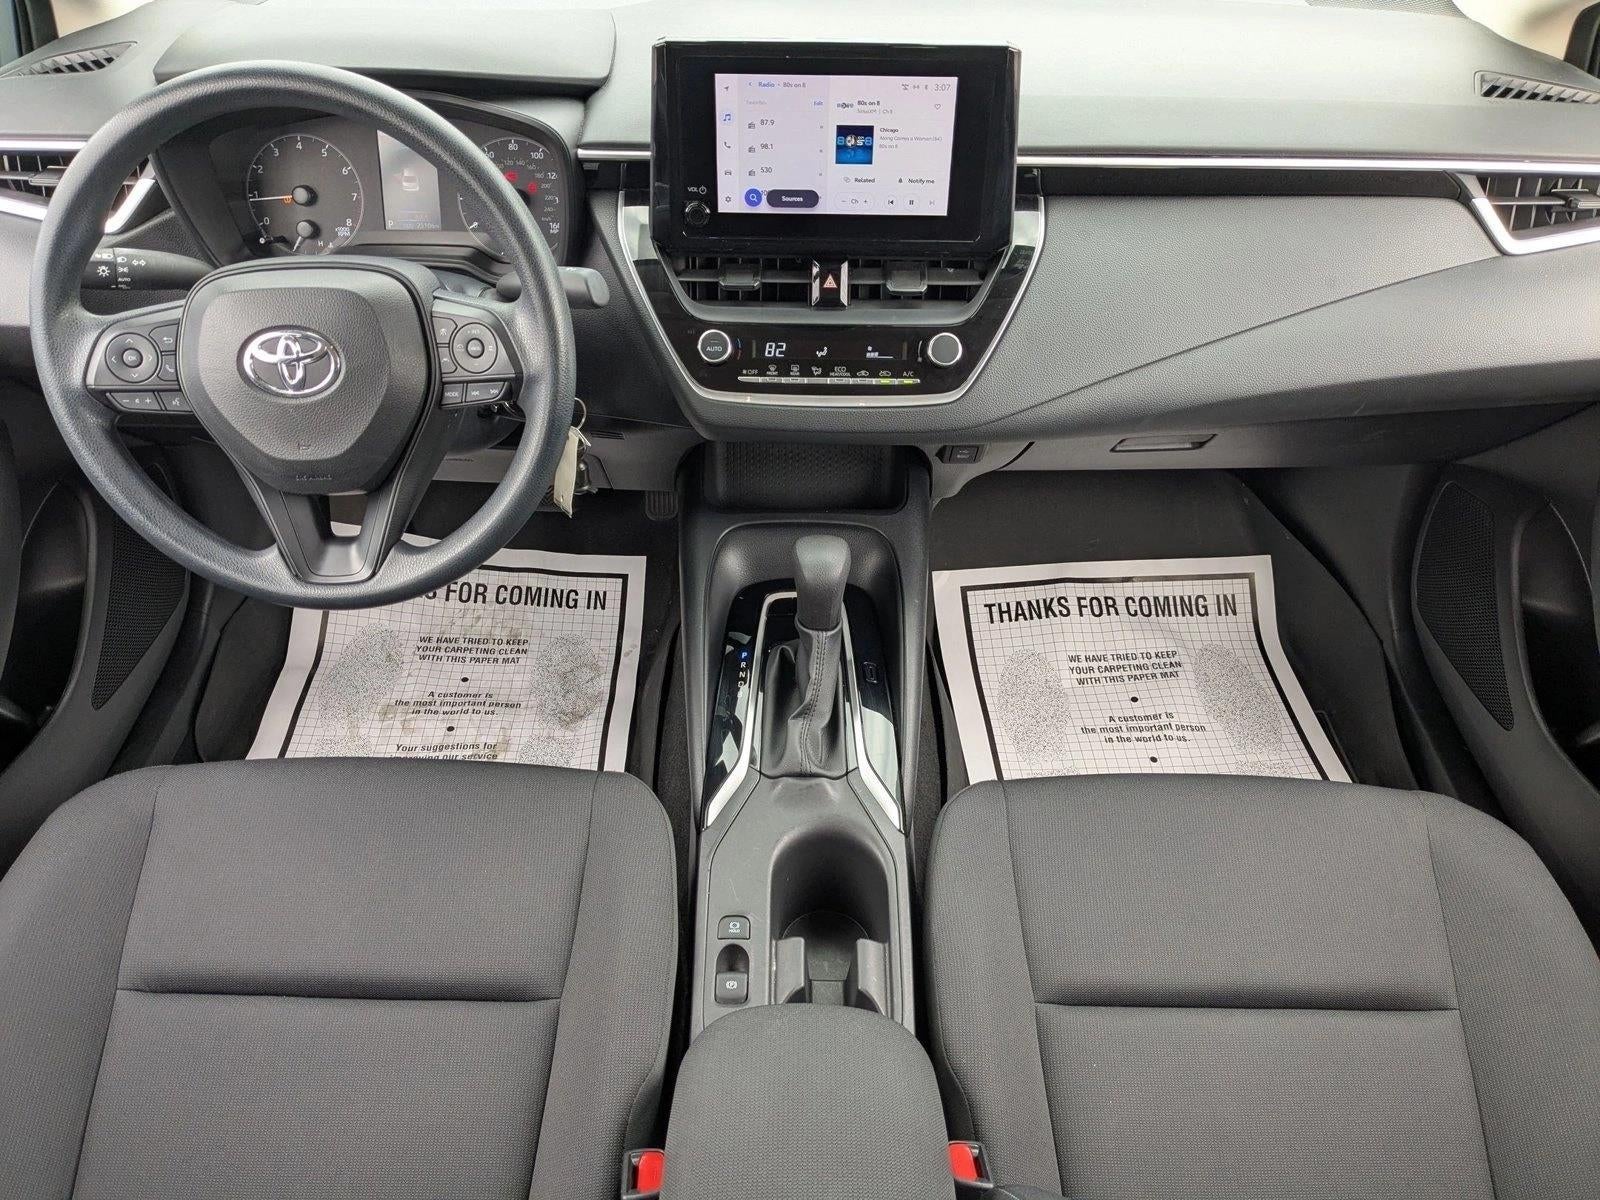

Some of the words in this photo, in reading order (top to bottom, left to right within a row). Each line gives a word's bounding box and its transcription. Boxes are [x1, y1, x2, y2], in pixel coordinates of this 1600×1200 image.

[934, 83, 951, 92] 3:07
[295, 142, 302, 150] 4
[508, 143, 519, 151] 80
[272, 149, 280, 157] 3
[321, 149, 328, 157] 5
[257, 165, 264, 174] 2
[342, 167, 349, 175] 6
[908, 178, 925, 186] Notify
[252, 191, 258, 199] 1
[351, 193, 358, 201] 7
[263, 217, 269, 225] 0
[346, 218, 353, 227] 8
[765, 342, 787, 357] 82
[445, 582, 488, 604] FOR
[495, 585, 578, 609] COMING
[586, 591, 607, 610] IN
[984, 595, 1071, 624] THANKS
[1077, 596, 1120, 618] FOR
[1125, 594, 1209, 617] COMING
[1216, 593, 1238, 616] IN
[419, 636, 434, 644] WE
[436, 636, 460, 645] HAVE
[463, 636, 489, 646] TRIED
[491, 638, 504, 646] TO
[506, 638, 529, 646] KEEP
[416, 645, 442, 653] YOUR
[444, 646, 496, 655] CARPETING
[498, 647, 528, 655] CLEAN
[419, 654, 443, 662] WITH
[445, 654, 467, 664] THIS
[469, 656, 499, 664] PAPER
[501, 656, 521, 664] MAT
[1068, 654, 1082, 663] WE
[1085, 654, 1108, 662] HAVE
[1110, 652, 1137, 661] TRIED
[1139, 652, 1152, 660] TO
[1155, 650, 1178, 658] KEEP
[1069, 666, 1095, 674] YOUR
[1097, 662, 1150, 674] CARPETING
[1152, 660, 1182, 670] CLEAN
[1076, 677, 1101, 686] WITH
[1103, 675, 1125, 684] THIS
[1127, 672, 1158, 682] PAPER
[1160, 670, 1180, 679] MAT
[427, 690, 435, 698] A
[437, 691, 482, 699] customer
[484, 691, 494, 699] is
[394, 699, 410, 707] the
[439, 699, 486, 710] important
[488, 701, 521, 710] person
[442, 708, 469, 716] world
[1108, 715, 1116, 723] A
[1118, 713, 1162, 723] customer
[1165, 711, 1175, 719] is
[1100, 725, 1124, 733] most
[1126, 722, 1173, 734] important
[1175, 723, 1207, 732] person
[1104, 735, 1114, 743] in
[1116, 735, 1132, 743] the
[1135, 733, 1162, 743] world
[1164, 733, 1174, 741] to
[1176, 734, 1191, 742] us.
[396, 743, 418, 752] Your
[420, 742, 480, 752] suggestions
[483, 742, 498, 750] for
